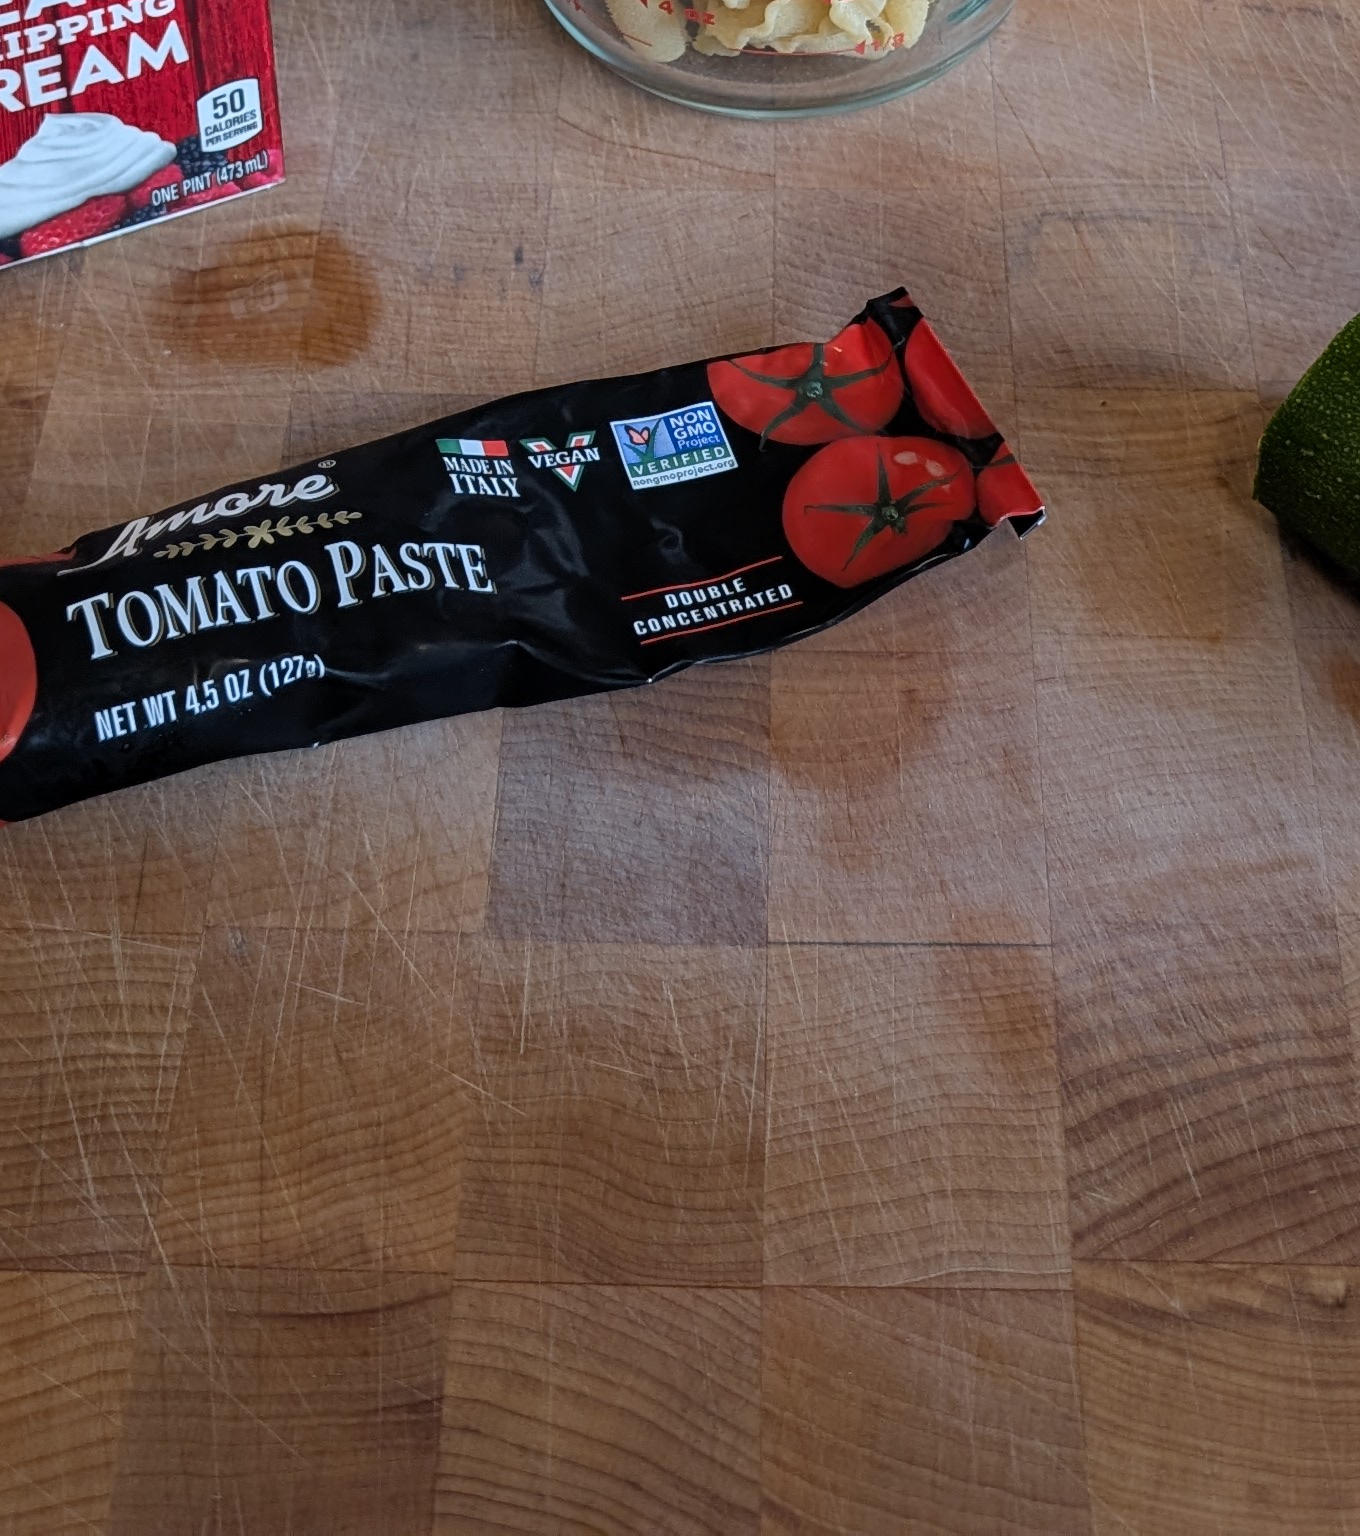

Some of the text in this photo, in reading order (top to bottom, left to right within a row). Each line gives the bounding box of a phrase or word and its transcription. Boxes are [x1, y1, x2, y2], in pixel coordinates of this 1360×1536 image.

[659, 0, 674, 15] 4
[212, 88, 245, 119] 50
[205, 109, 257, 136] CALORIES
[206, 121, 258, 147] PER SERVING
[152, 184, 179, 206] ONE
[183, 172, 212, 196] PINT
[669, 408, 712, 429] NON
[673, 422, 716, 440] GMO
[677, 434, 721, 450] Project
[442, 456, 515, 475] MADE IN
[527, 446, 601, 469] VEGAN
[632, 446, 725, 475] VERIFIED
[449, 473, 521, 498] ITALY
[633, 458, 736, 487] nongmoproject.org
[57, 473, 340, 577] Amore
[66, 540, 498, 661] TOMATO PASTE
[664, 576, 747, 609] DOUBLE
[633, 583, 793, 636] CONCENTRATED
[94, 653, 326, 744] NET WT 4.5 OZ (127g)
